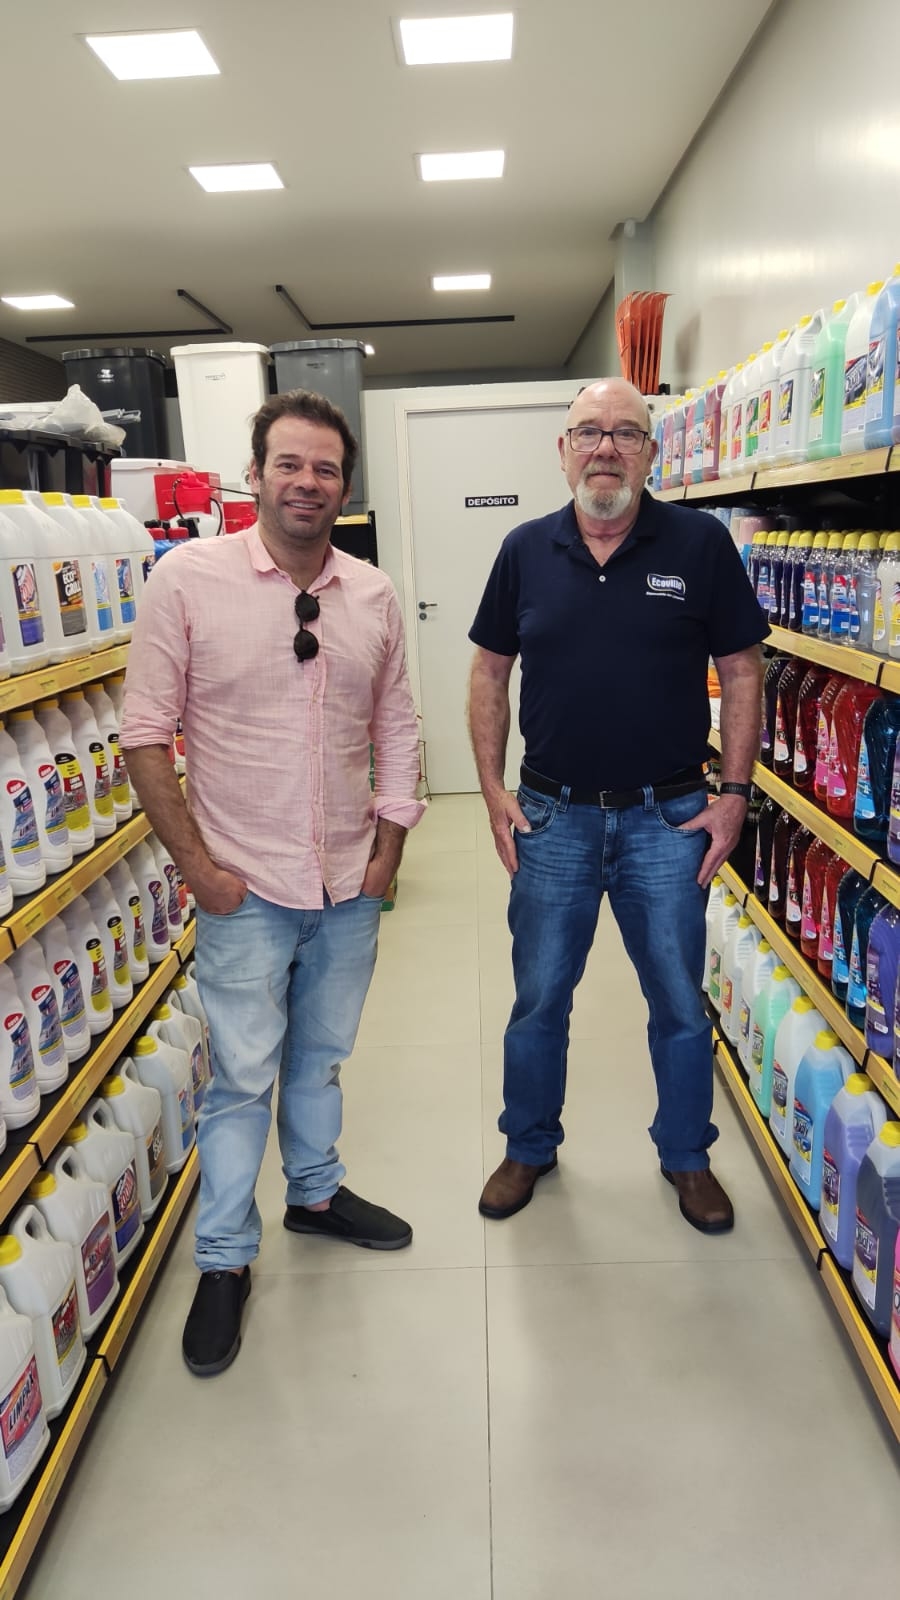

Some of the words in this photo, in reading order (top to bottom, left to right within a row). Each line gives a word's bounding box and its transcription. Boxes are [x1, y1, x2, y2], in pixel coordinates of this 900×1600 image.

[467, 496, 516, 507] DEPÓSITO
[62, 571, 76, 585] ECO
[65, 580, 82, 597] GRILL
